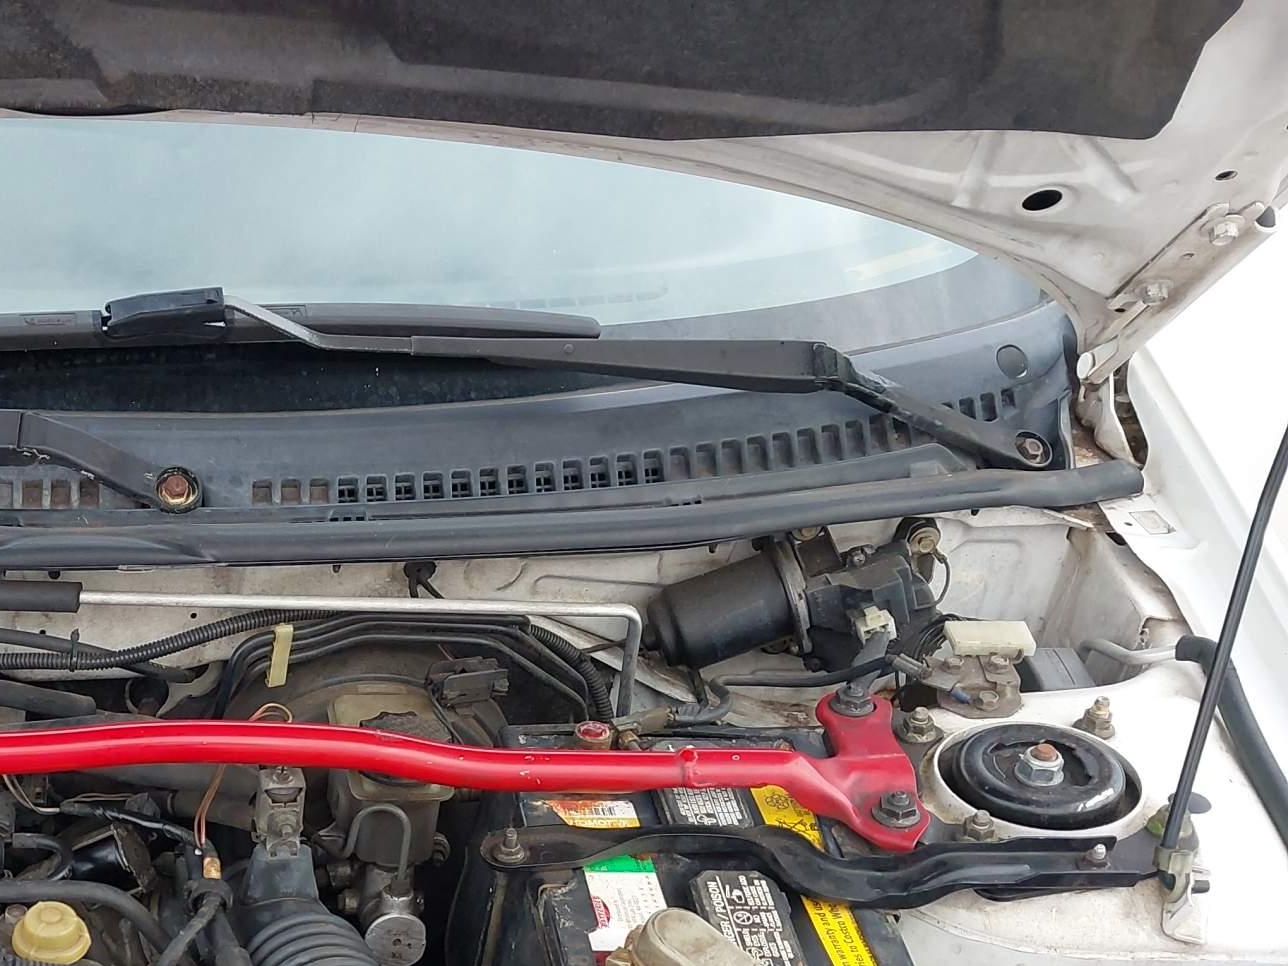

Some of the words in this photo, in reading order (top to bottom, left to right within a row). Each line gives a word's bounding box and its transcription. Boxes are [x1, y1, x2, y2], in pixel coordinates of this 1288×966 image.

[707, 881, 726, 913] POISON
[720, 921, 736, 945] NGER
[815, 912, 830, 927] and
[826, 929, 847, 961] warranty
